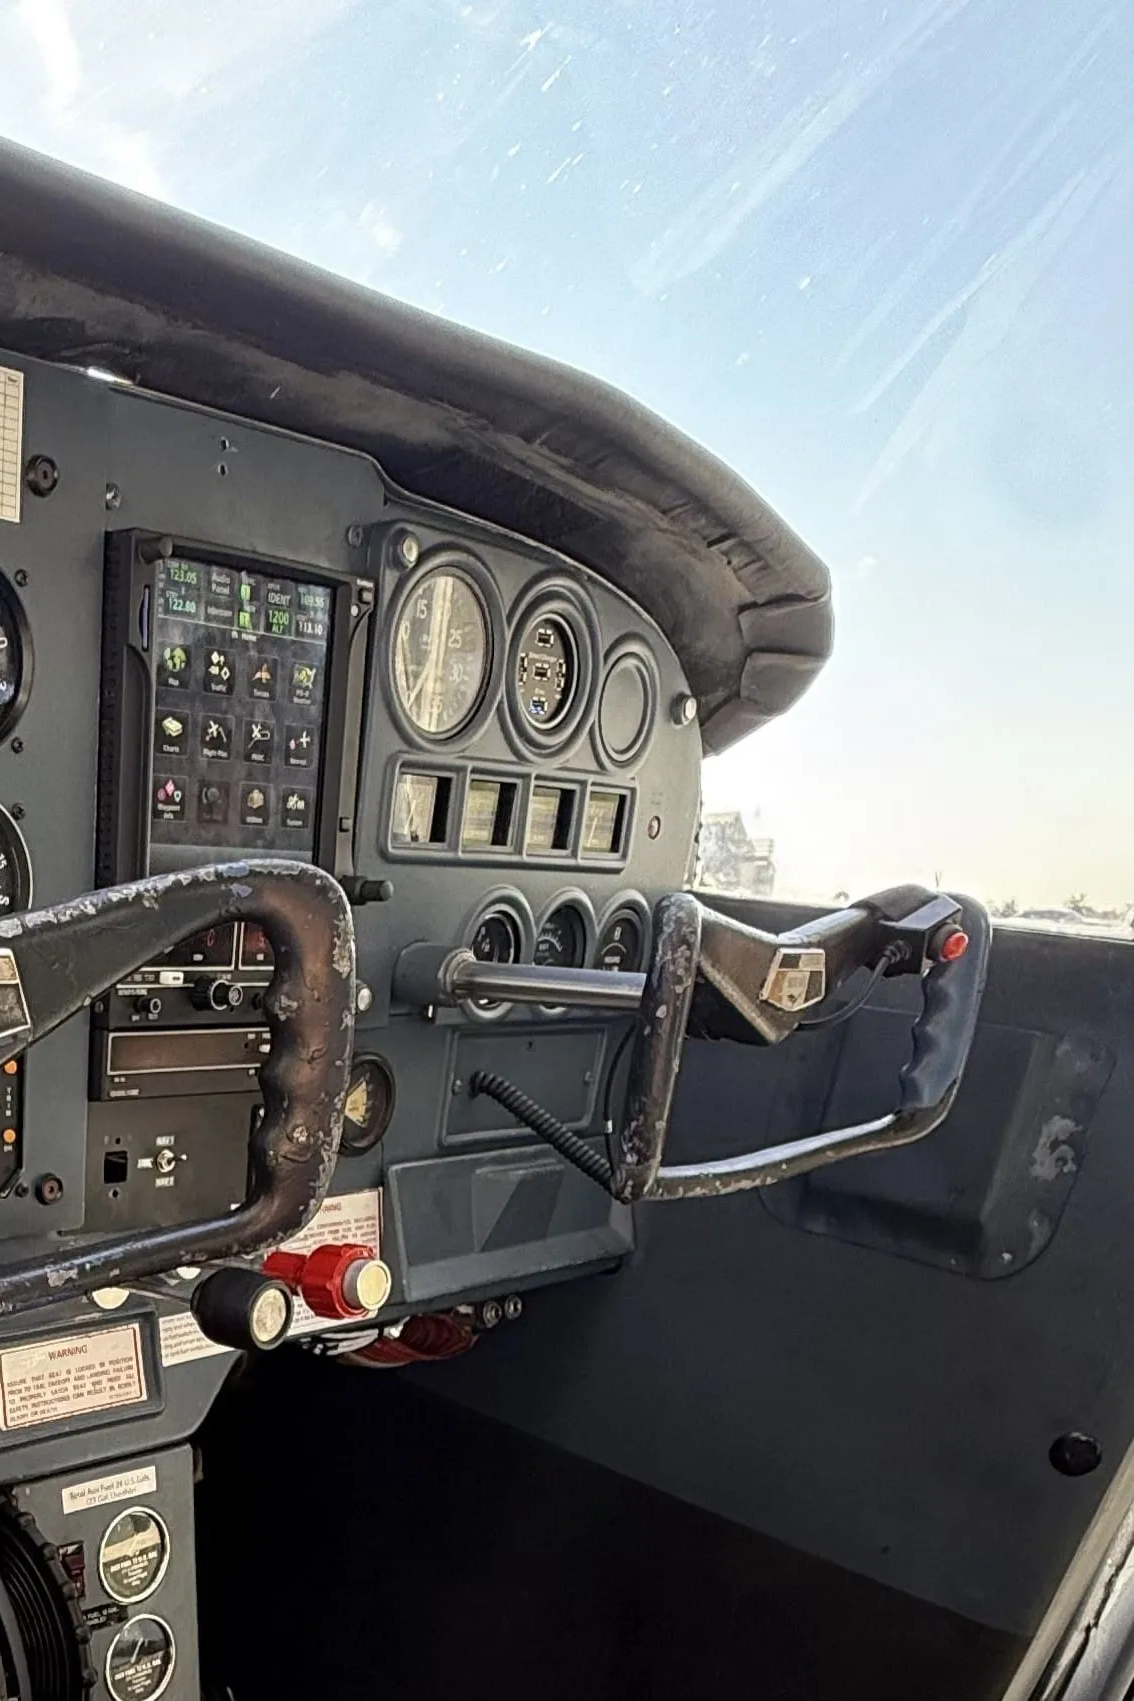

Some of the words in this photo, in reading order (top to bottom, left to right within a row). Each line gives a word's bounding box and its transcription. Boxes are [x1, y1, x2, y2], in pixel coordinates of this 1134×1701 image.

[268, 593, 291, 606] IDENT
[269, 610, 289, 625] 1200
[417, 600, 427, 619] 15
[448, 629, 462, 648] 25
[450, 664, 464, 682] 30
[48, 1345, 88, 1360] WARNING
